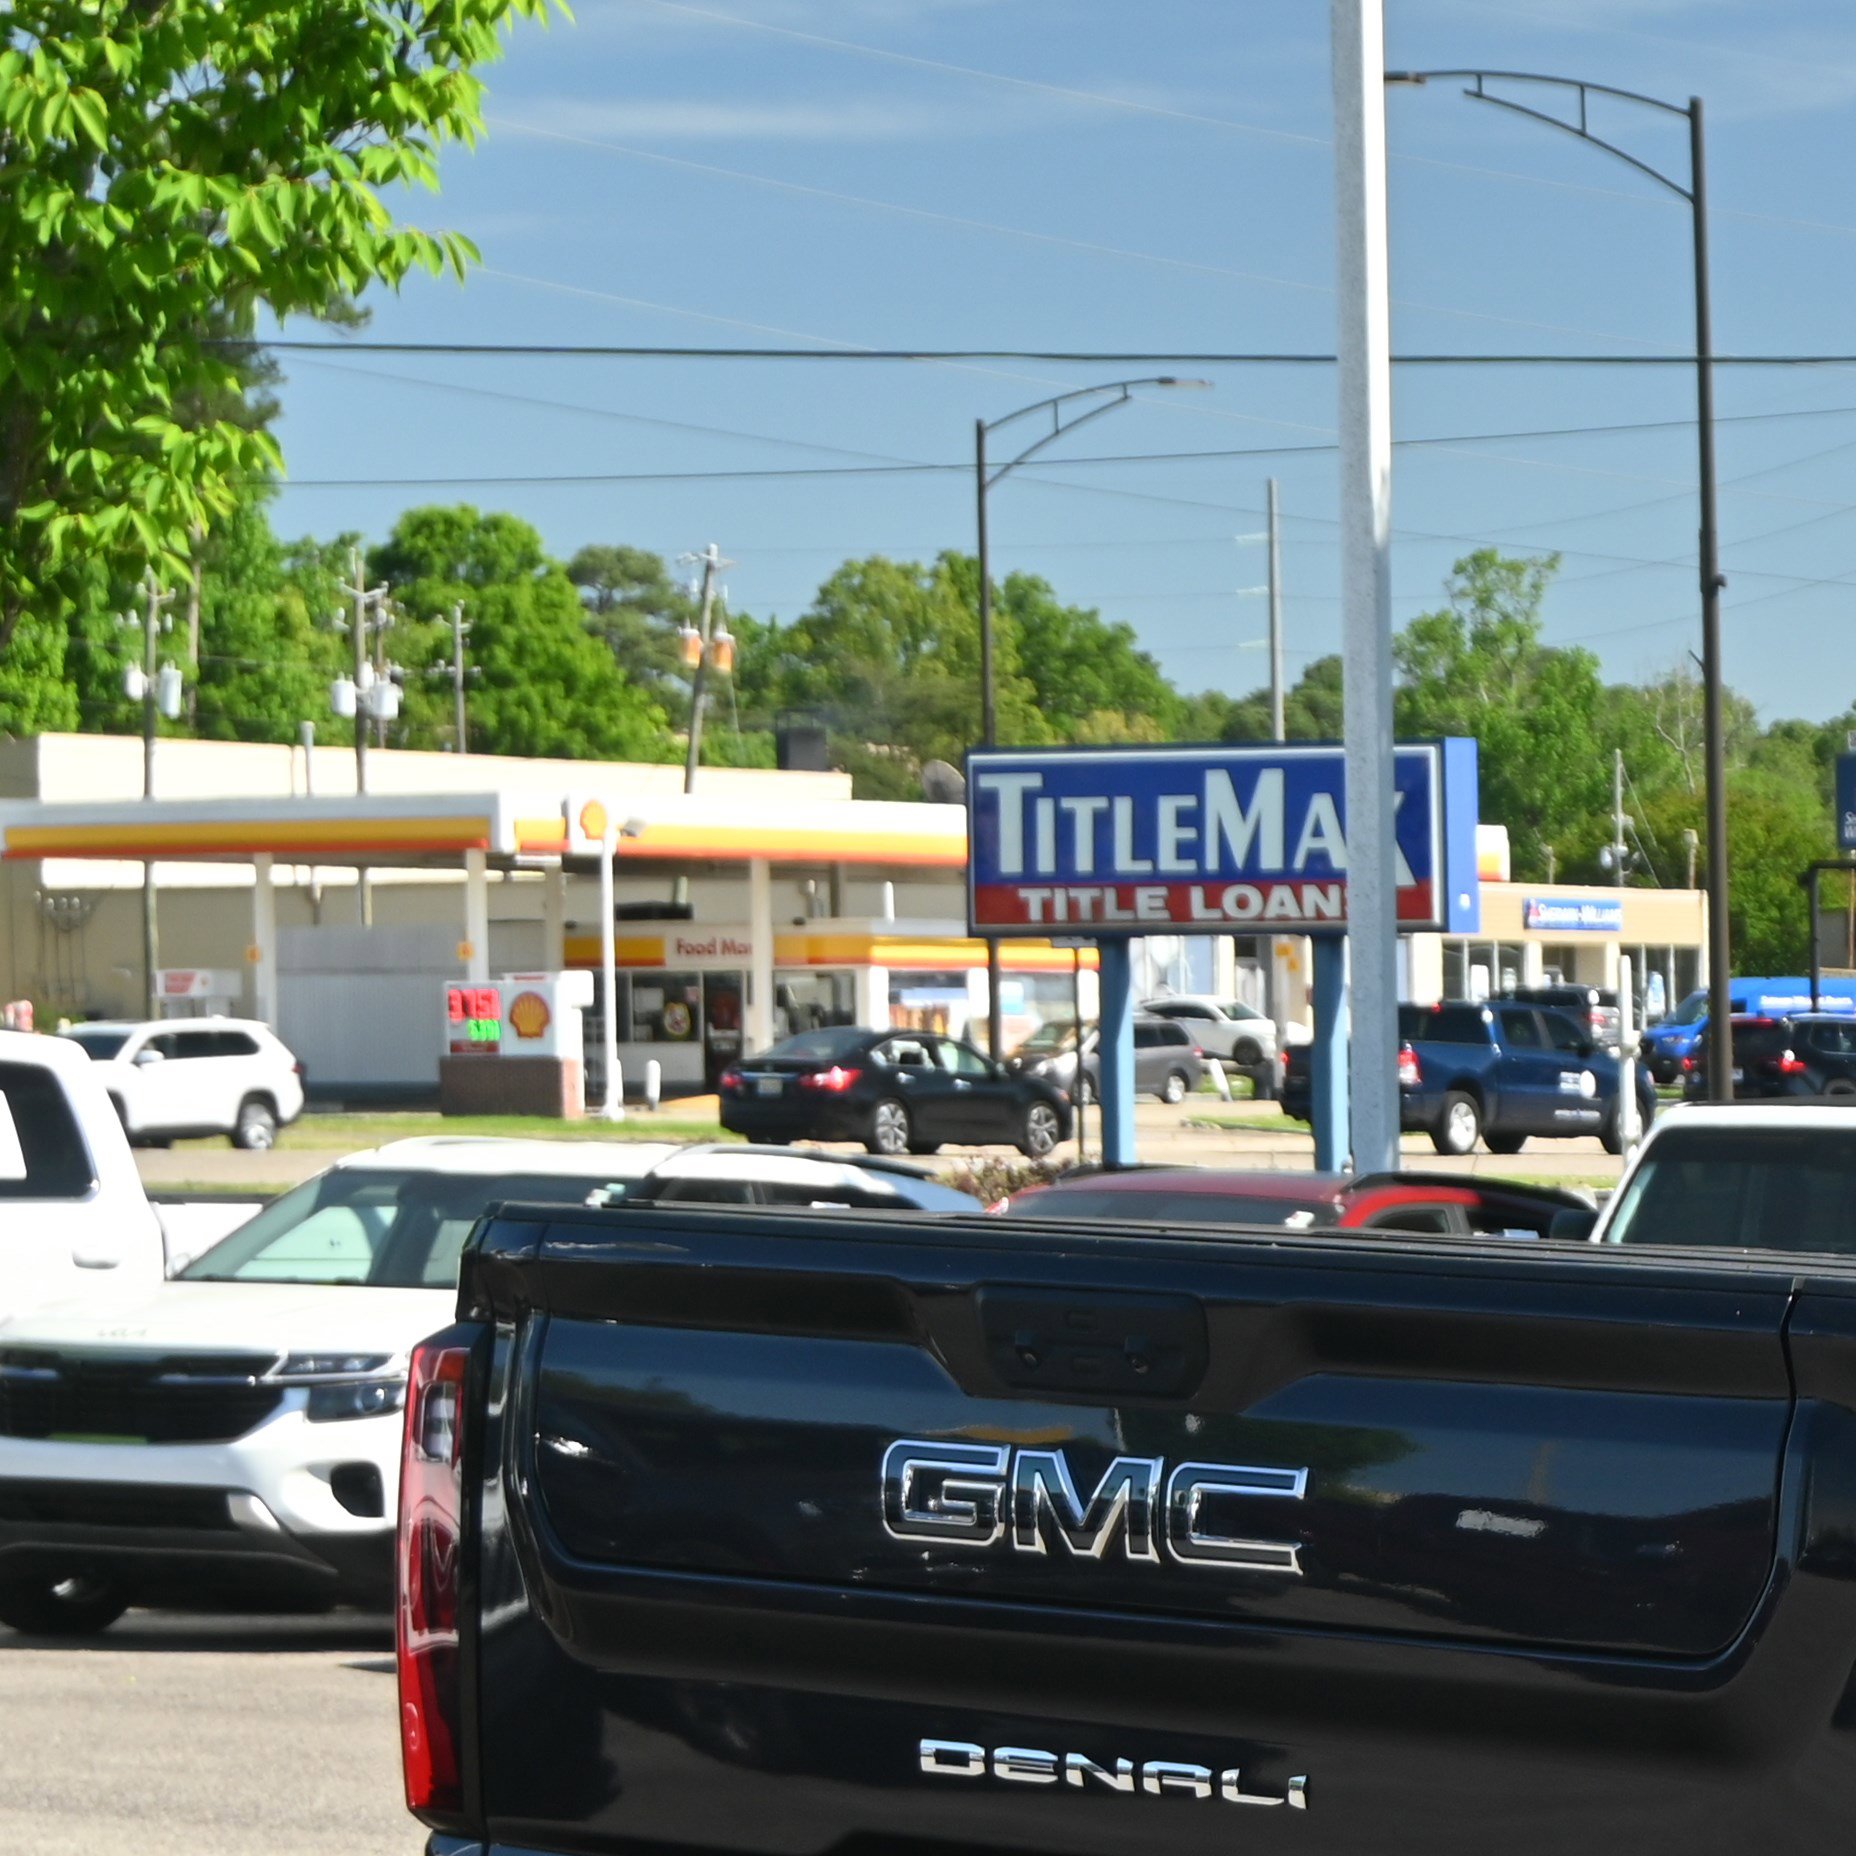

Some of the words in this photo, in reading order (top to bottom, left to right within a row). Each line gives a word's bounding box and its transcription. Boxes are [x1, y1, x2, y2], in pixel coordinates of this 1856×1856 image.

[1018, 887, 1169, 922] TITLE
[1191, 883, 1347, 921] LOAN
[676, 937, 717, 955] Food
[882, 1439, 1308, 1575] GMC
[919, 1738, 1308, 1809] DENALI
